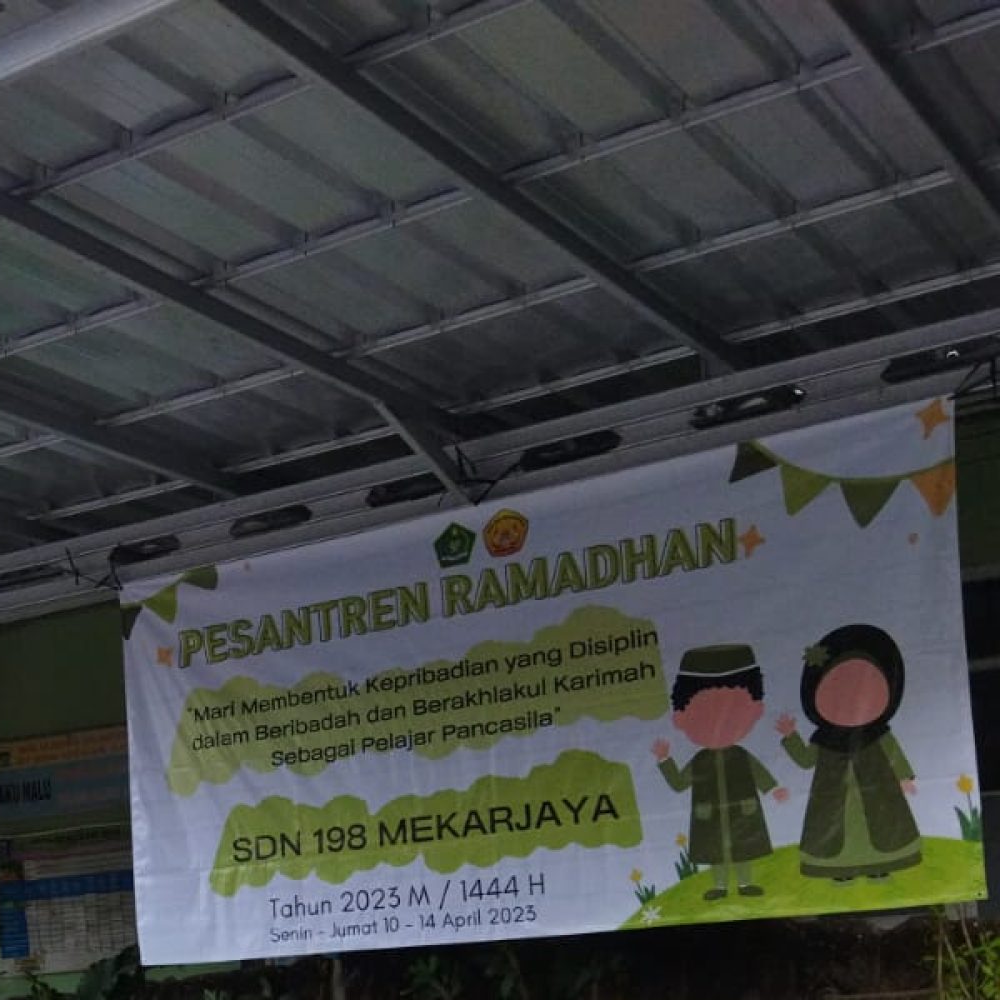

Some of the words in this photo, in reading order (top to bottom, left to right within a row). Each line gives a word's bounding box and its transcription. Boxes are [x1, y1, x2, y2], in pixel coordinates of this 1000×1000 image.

[178, 581, 431, 669] PESANTREN
[440, 518, 737, 617] RAMADHAN
[241, 679, 361, 715] Membentuk
[366, 658, 499, 693] Kepribadian
[505, 648, 562, 674] yang
[569, 628, 659, 660] Disiplin
[192, 729, 249, 751] dalam
[255, 710, 361, 741] Beribadah
[366, 703, 406, 724] dan
[413, 679, 546, 716] Berakhlakul
[554, 661, 656, 693] Karimah
[271, 738, 356, 766] Sebagai
[362, 729, 436, 754] Pelajar
[233, 830, 302, 862] SDN
[313, 824, 367, 854] 198
[379, 794, 620, 847] MEKARJAYA
[269, 894, 333, 919] Tahun
[340, 886, 401, 913] 2023
[408, 884, 430, 907] M
[439, 879, 451, 910] /
[460, 874, 520, 902] 1444
[529, 872, 545, 895] H
[270, 927, 312, 942] Senin
[330, 920, 378, 938] Jumat
[384, 916, 399, 933] 10
[418, 913, 436, 929] 14
[442, 908, 481, 932] April
[489, 905, 537, 925] 2023
